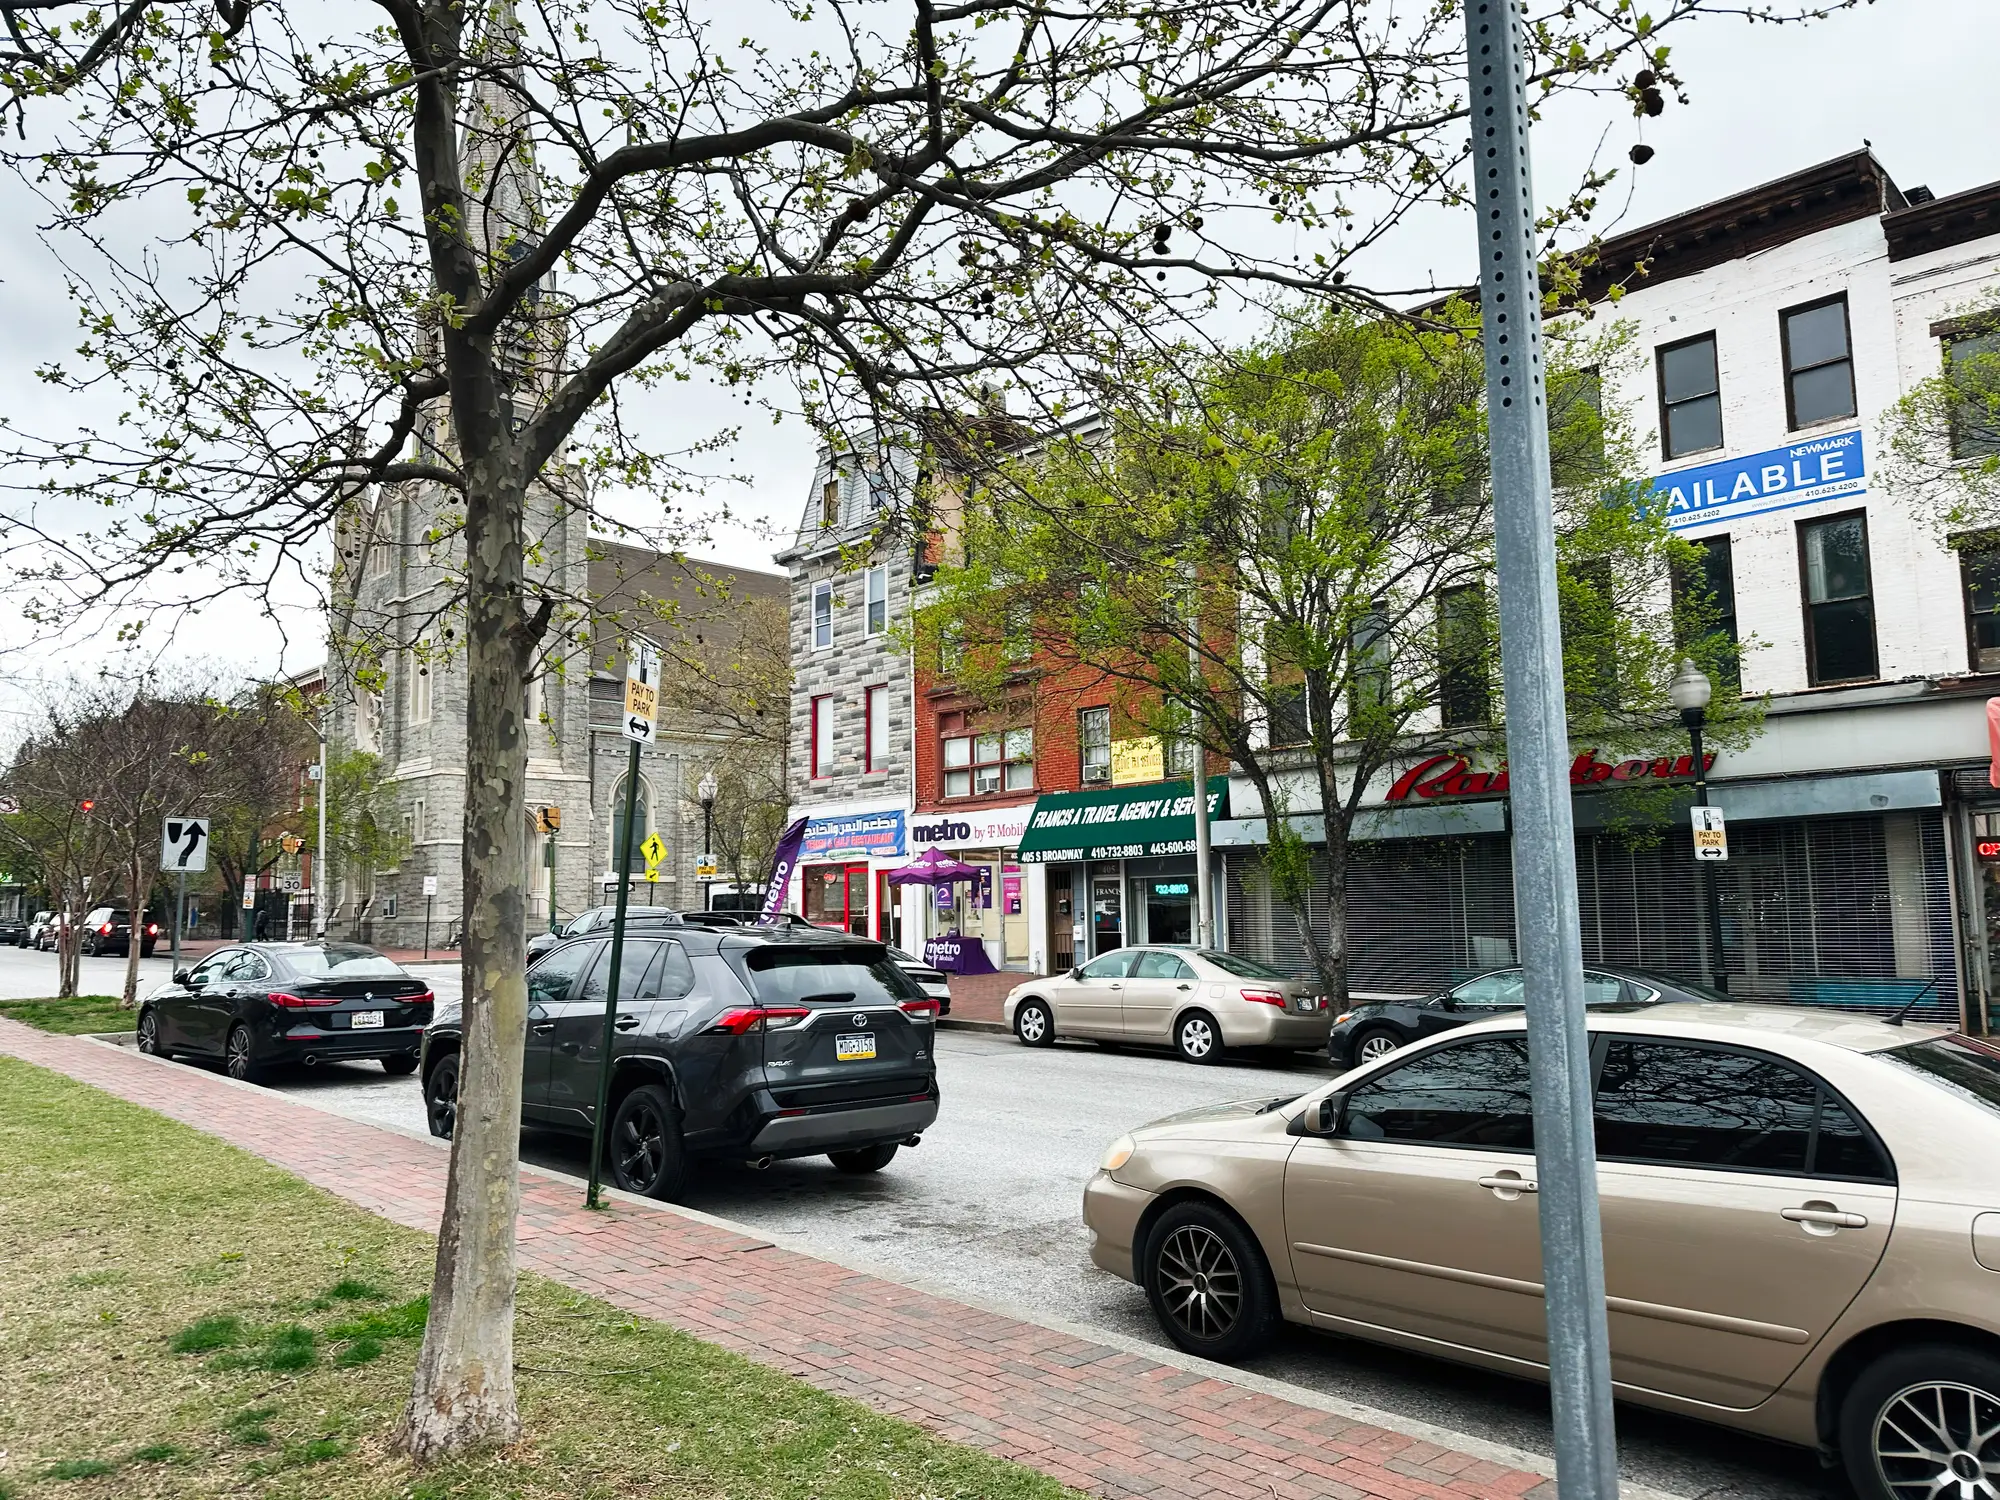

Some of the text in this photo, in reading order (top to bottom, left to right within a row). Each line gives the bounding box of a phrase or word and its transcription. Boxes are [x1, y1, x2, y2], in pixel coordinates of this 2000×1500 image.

[1790, 435, 1855, 459] NEWMARK
[1655, 450, 1846, 512] AILABLE
[1805, 481, 1858, 498] 410.625.4200
[1673, 509, 1721, 525] 410.625.4202
[631, 682, 655, 703] PAY TO
[632, 698, 651, 717] PARK
[1384, 749, 1716, 801] Raibow
[1031, 793, 1219, 829] FRANCIS A TRAVEL AGENCY & SERE
[863, 817, 898, 833] مطعم
[913, 819, 971, 842] metro
[974, 826, 985, 842] by
[851, 832, 895, 845] RESTAURANT
[1698, 831, 1710, 839] PAY
[1701, 838, 1720, 846] PARK
[1021, 840, 1197, 863] 405 S BROADWAY 410-732-8803 443-600-68
[1978, 842, 2000, 856] OP
[1102, 865, 1116, 874] 405
[284, 881, 300, 890] 30
[760, 861, 788, 924] metro
[926, 940, 961, 955] metro
